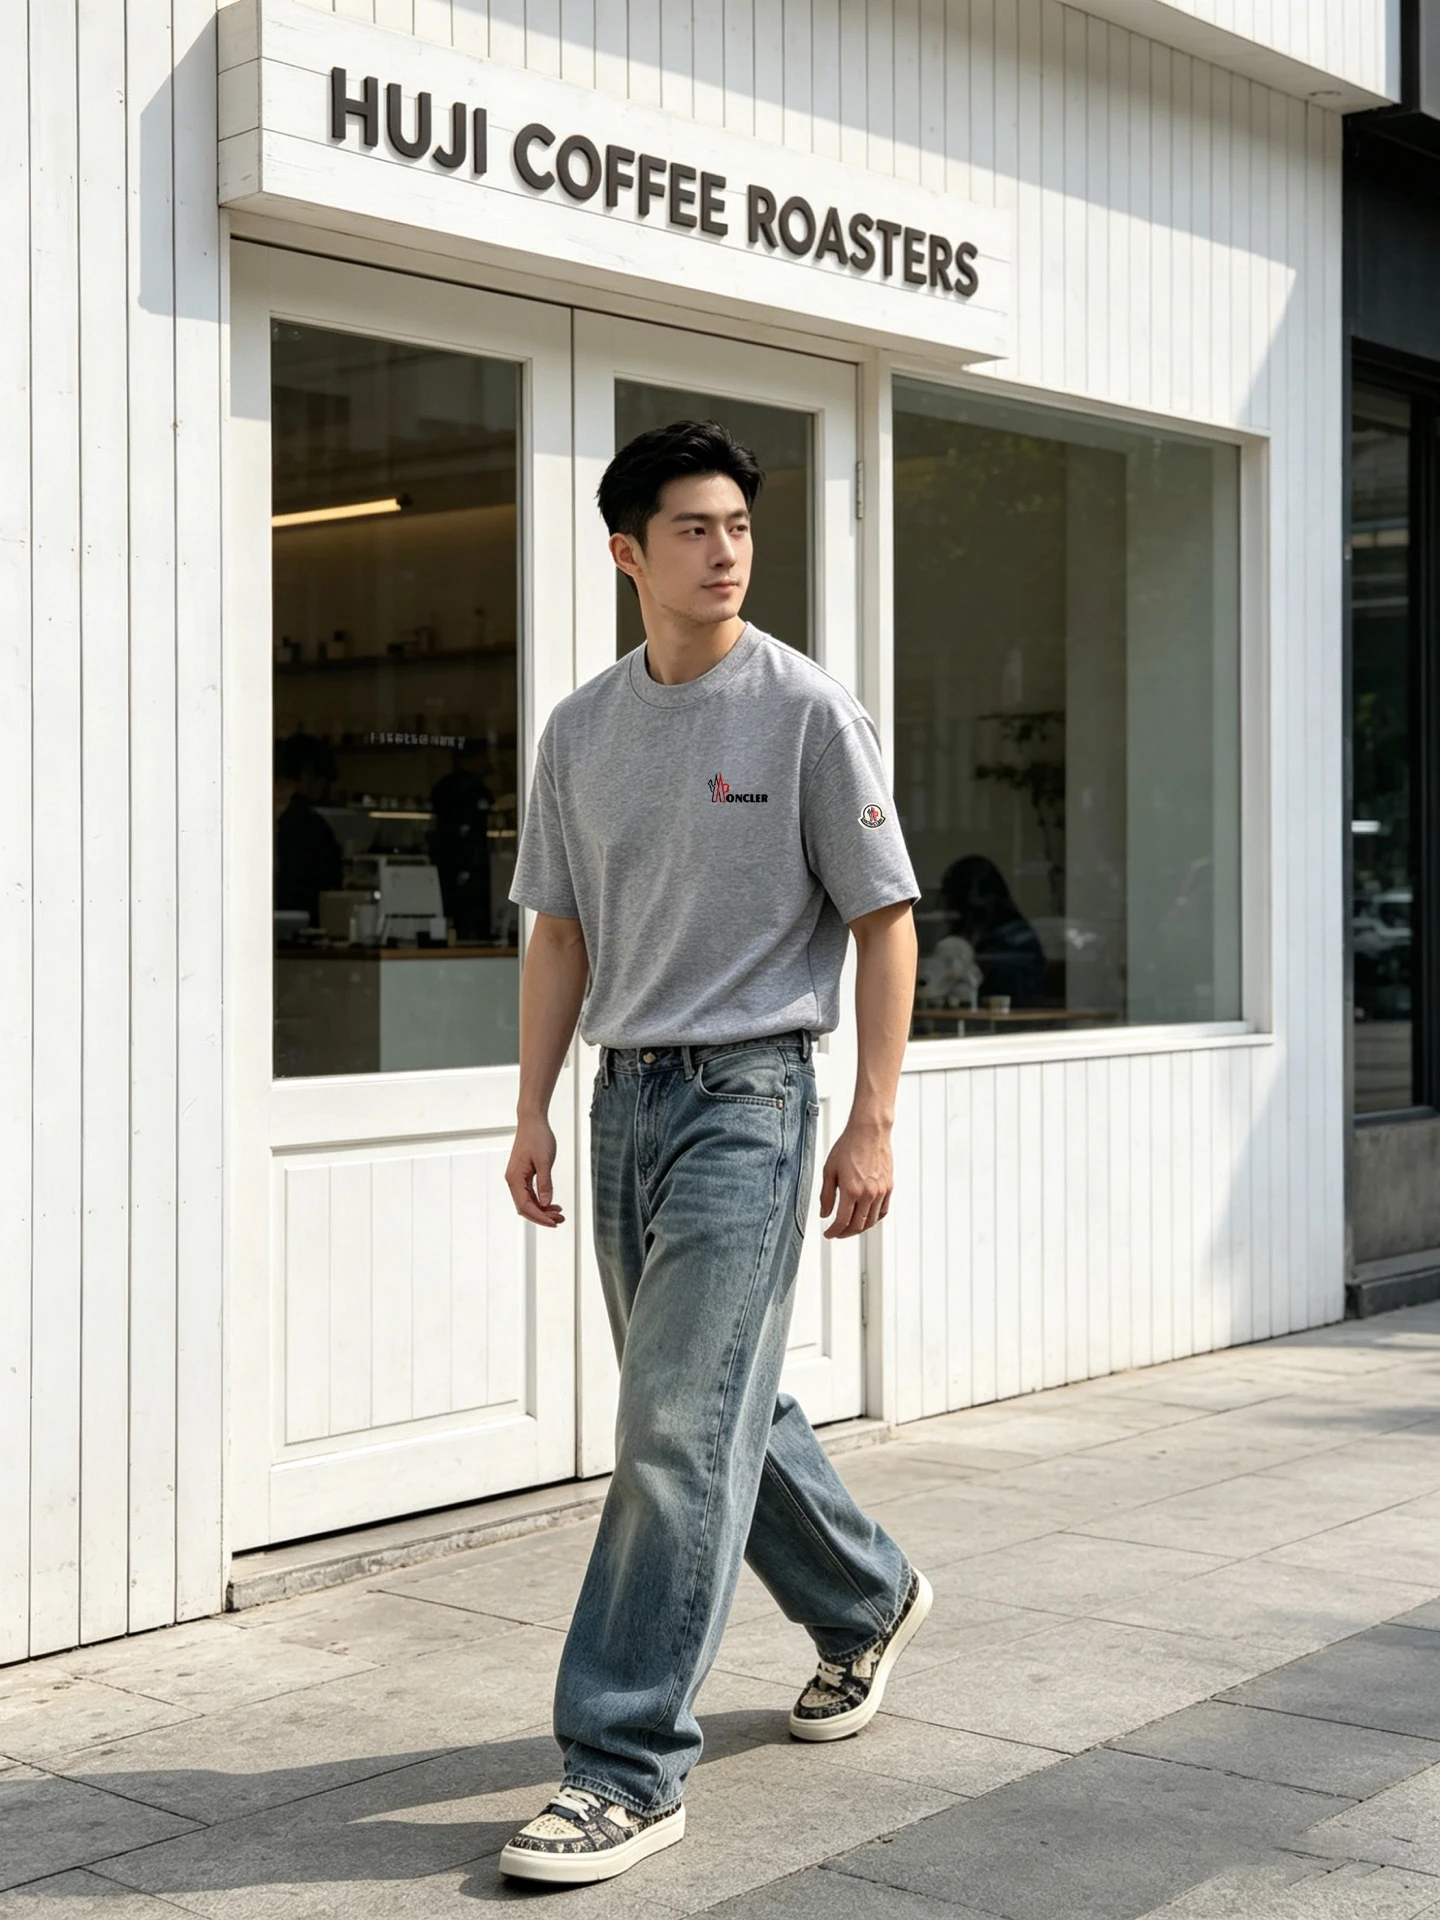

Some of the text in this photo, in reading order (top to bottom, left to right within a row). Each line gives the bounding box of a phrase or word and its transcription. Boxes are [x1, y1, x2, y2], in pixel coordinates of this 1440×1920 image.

[330, 67, 980, 298] HUJI COFFEE ROASTERS
